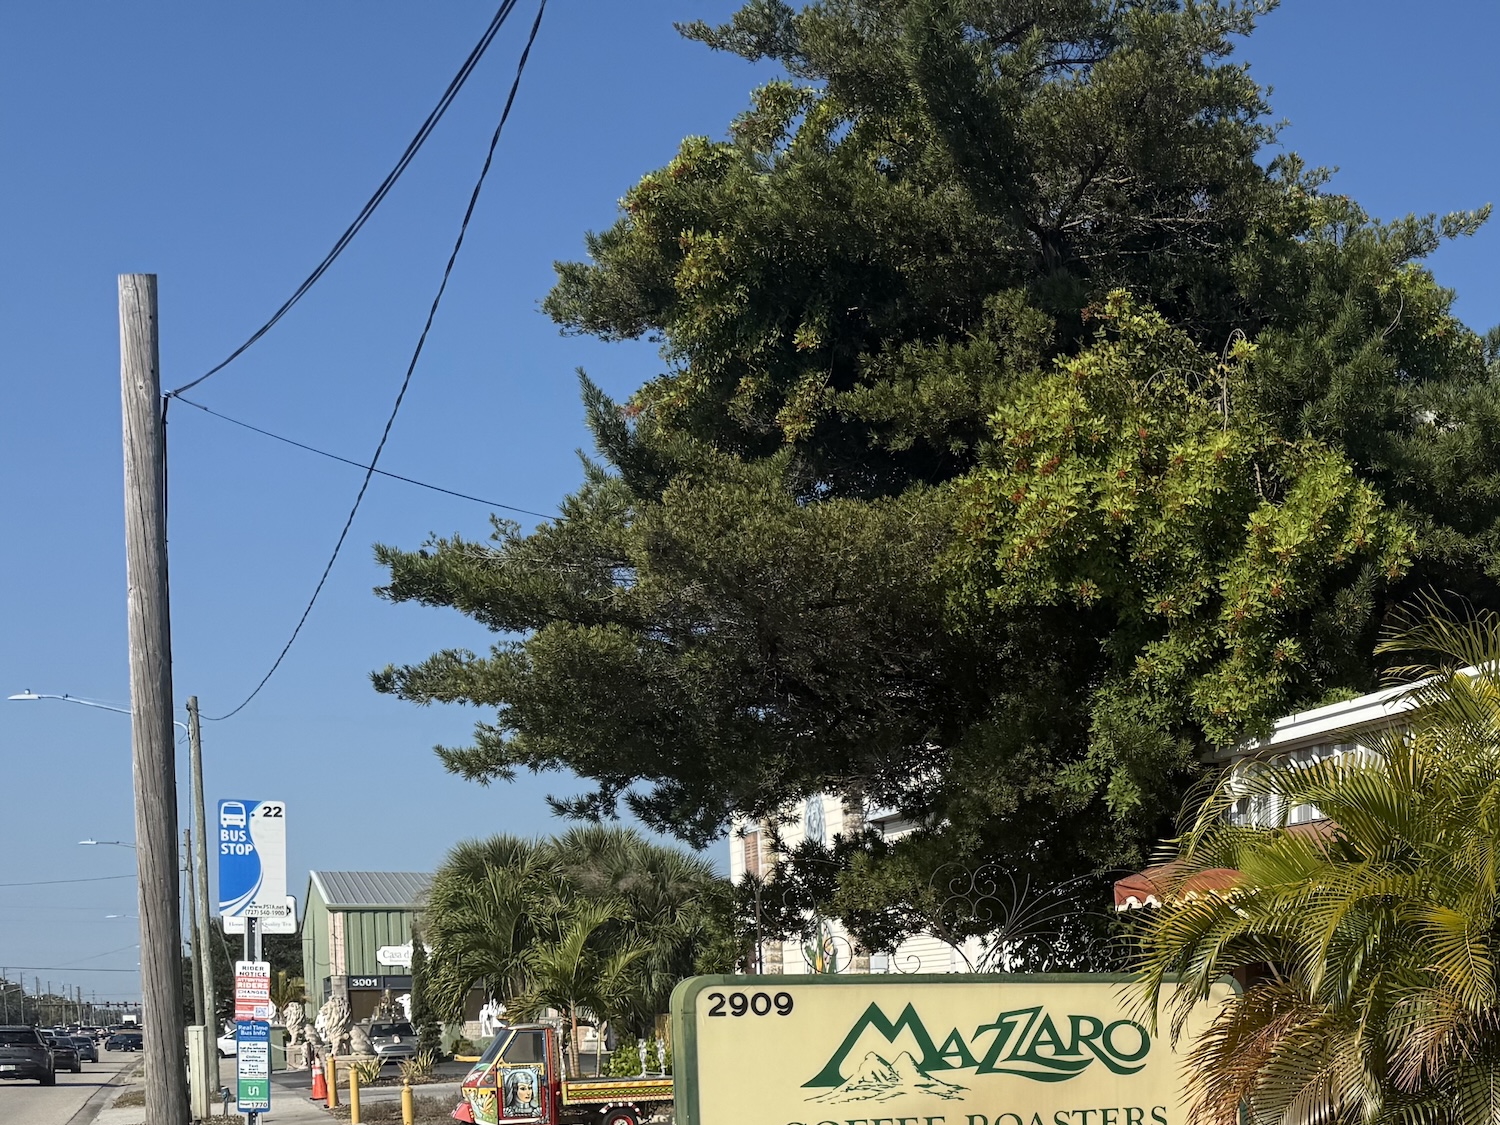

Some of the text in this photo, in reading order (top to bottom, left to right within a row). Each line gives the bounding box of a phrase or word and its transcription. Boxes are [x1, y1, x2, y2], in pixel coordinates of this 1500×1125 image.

[263, 806, 282, 817] 22
[221, 829, 246, 841] BUS
[221, 843, 254, 855] STOP
[245, 909, 259, 917] (727)
[382, 949, 402, 959] Casa
[352, 978, 378, 987] 3001
[707, 991, 794, 1018] 2909
